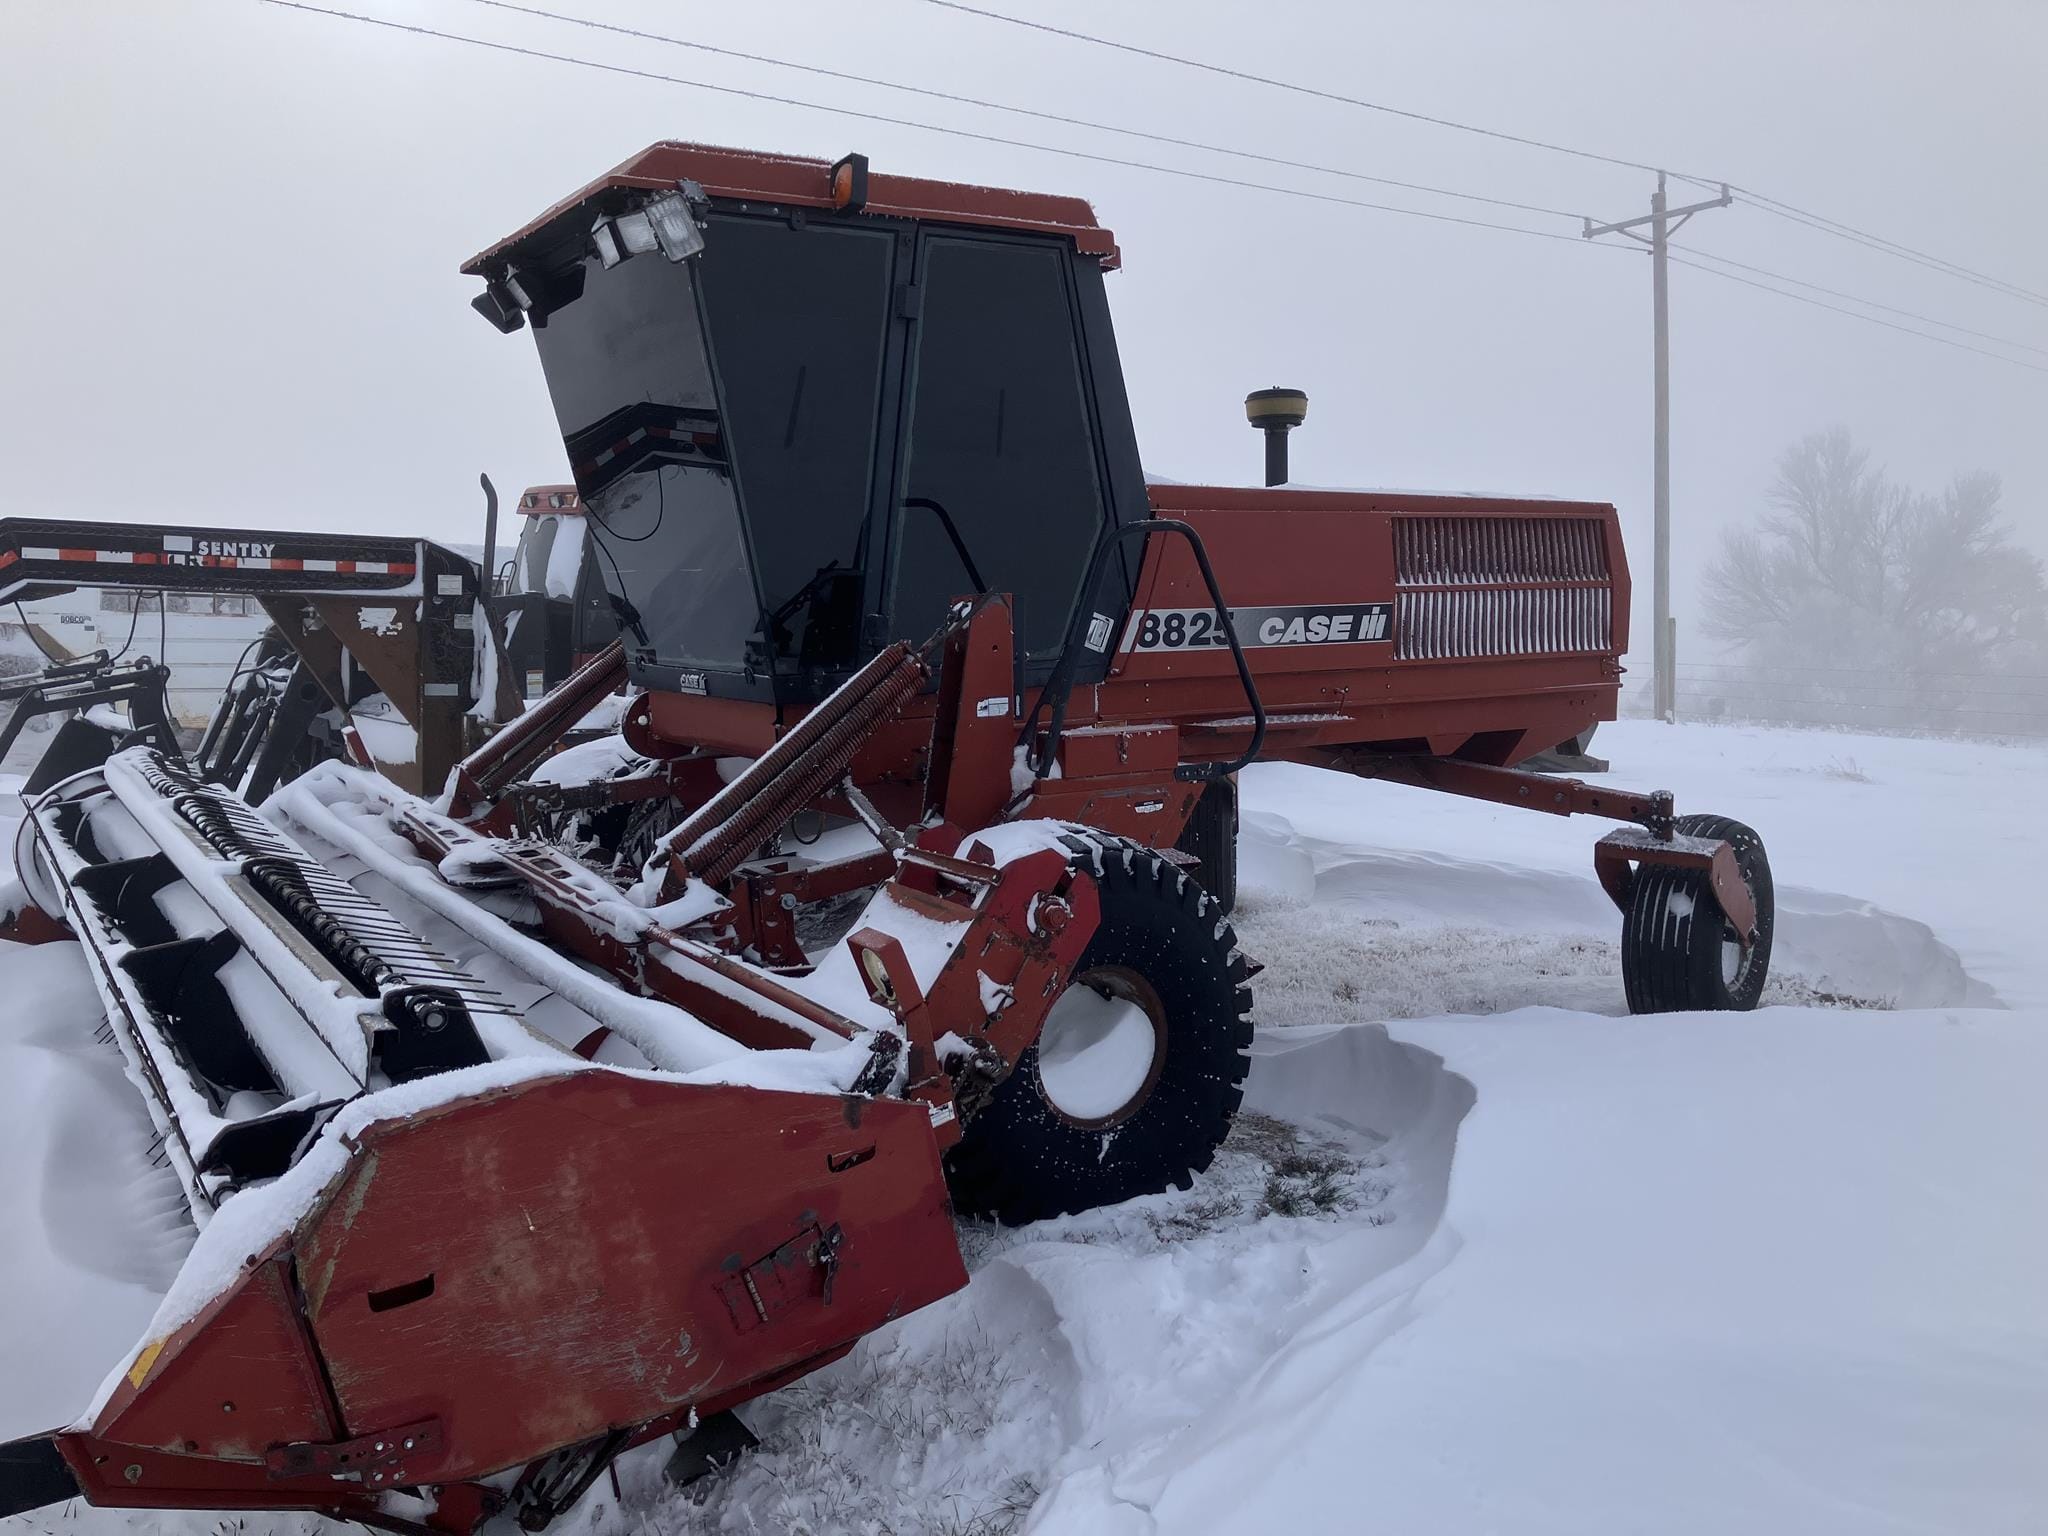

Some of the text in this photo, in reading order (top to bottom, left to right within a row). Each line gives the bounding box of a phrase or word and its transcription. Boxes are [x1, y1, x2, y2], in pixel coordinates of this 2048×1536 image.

[198, 541, 276, 558] SENTRY
[1137, 612, 1234, 648] 8825
[1258, 615, 1354, 645] CASE
